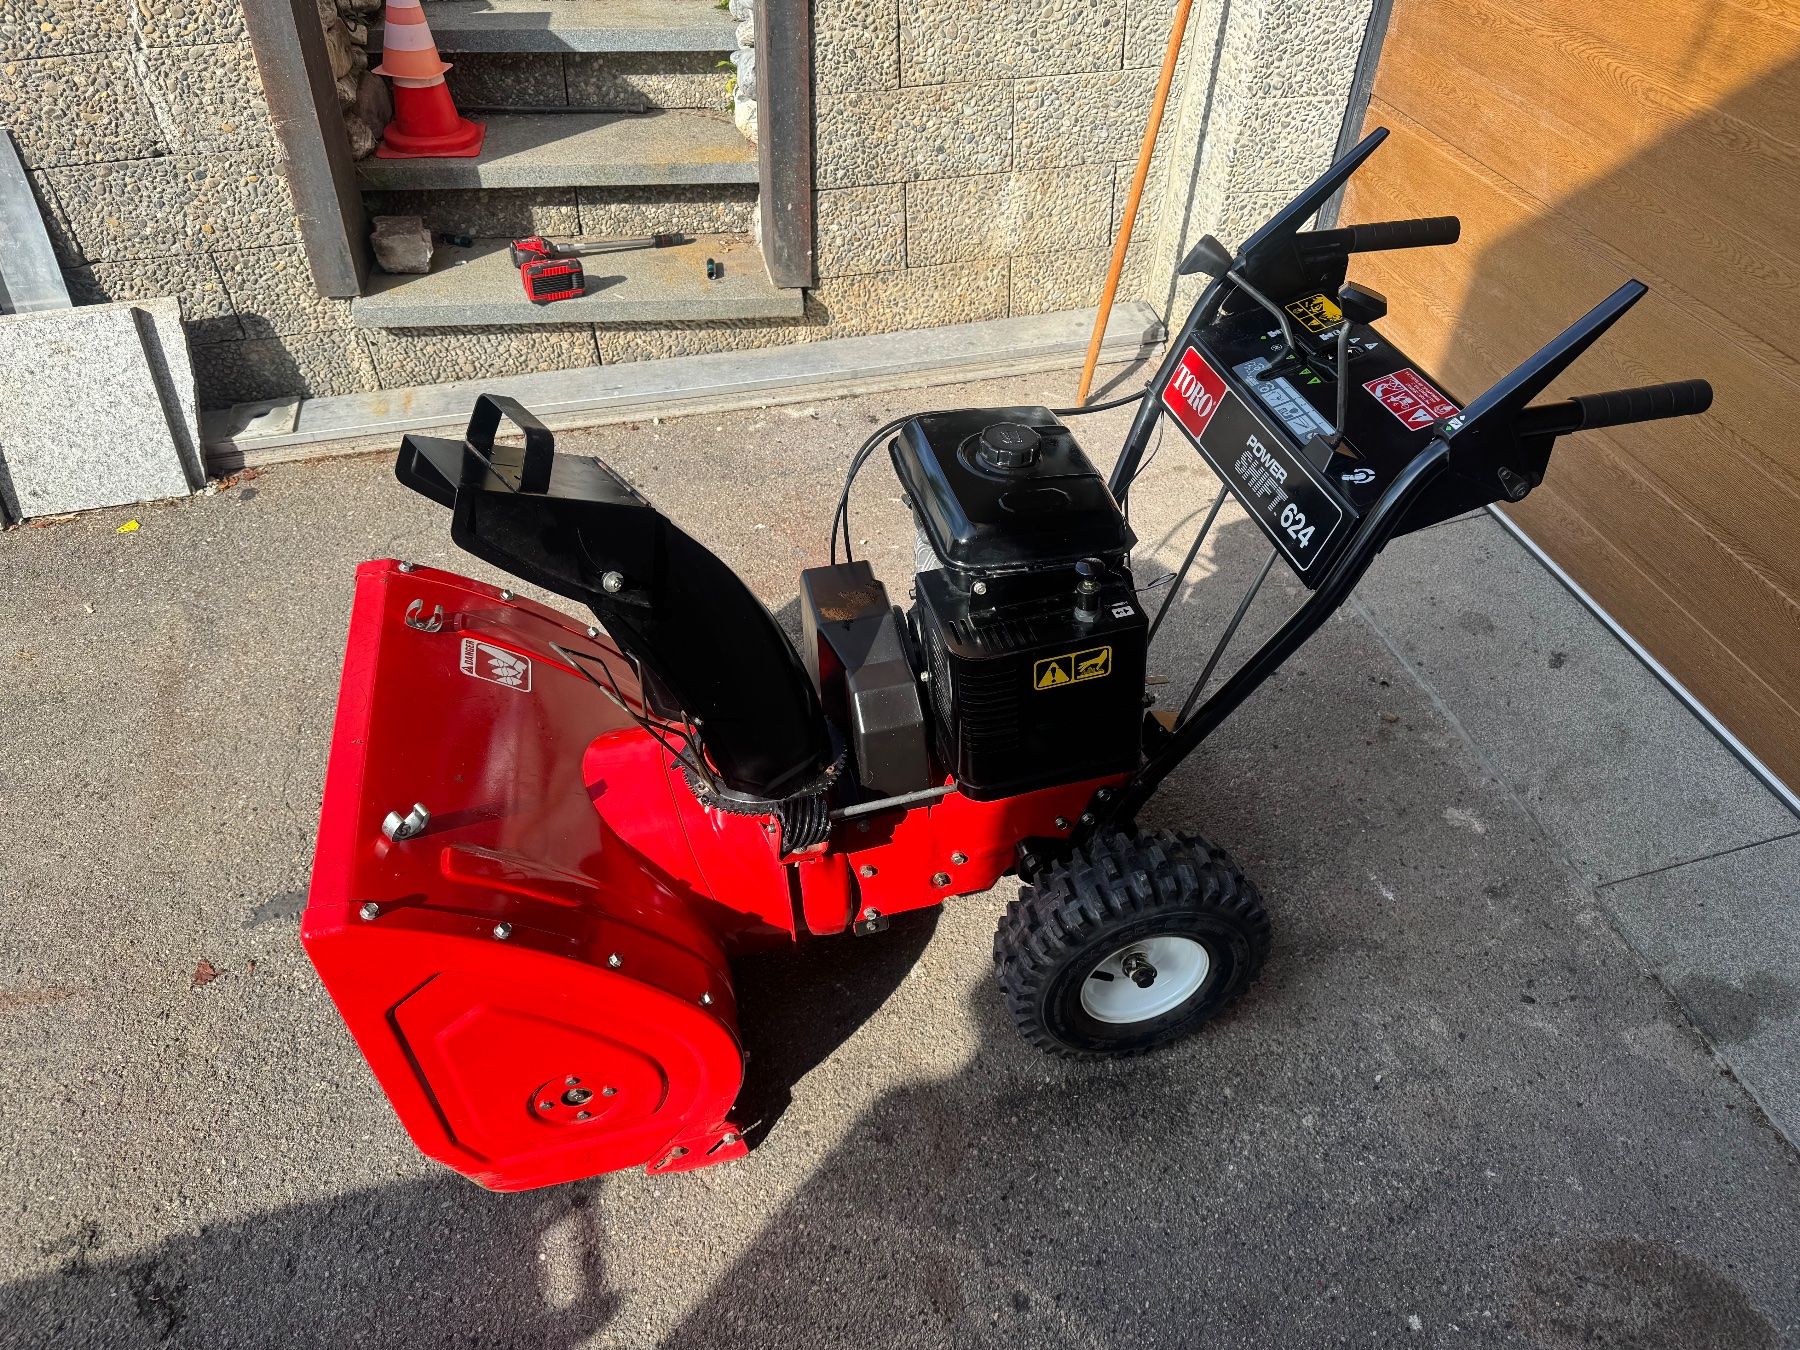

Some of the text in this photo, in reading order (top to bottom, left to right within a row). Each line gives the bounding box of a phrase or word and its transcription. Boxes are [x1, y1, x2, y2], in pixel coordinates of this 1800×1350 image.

[1173, 363, 1213, 418] TORO
[1246, 434, 1288, 484] POWER
[1234, 450, 1316, 549] SHIFT 624
[464, 640, 475, 666] DANGER
